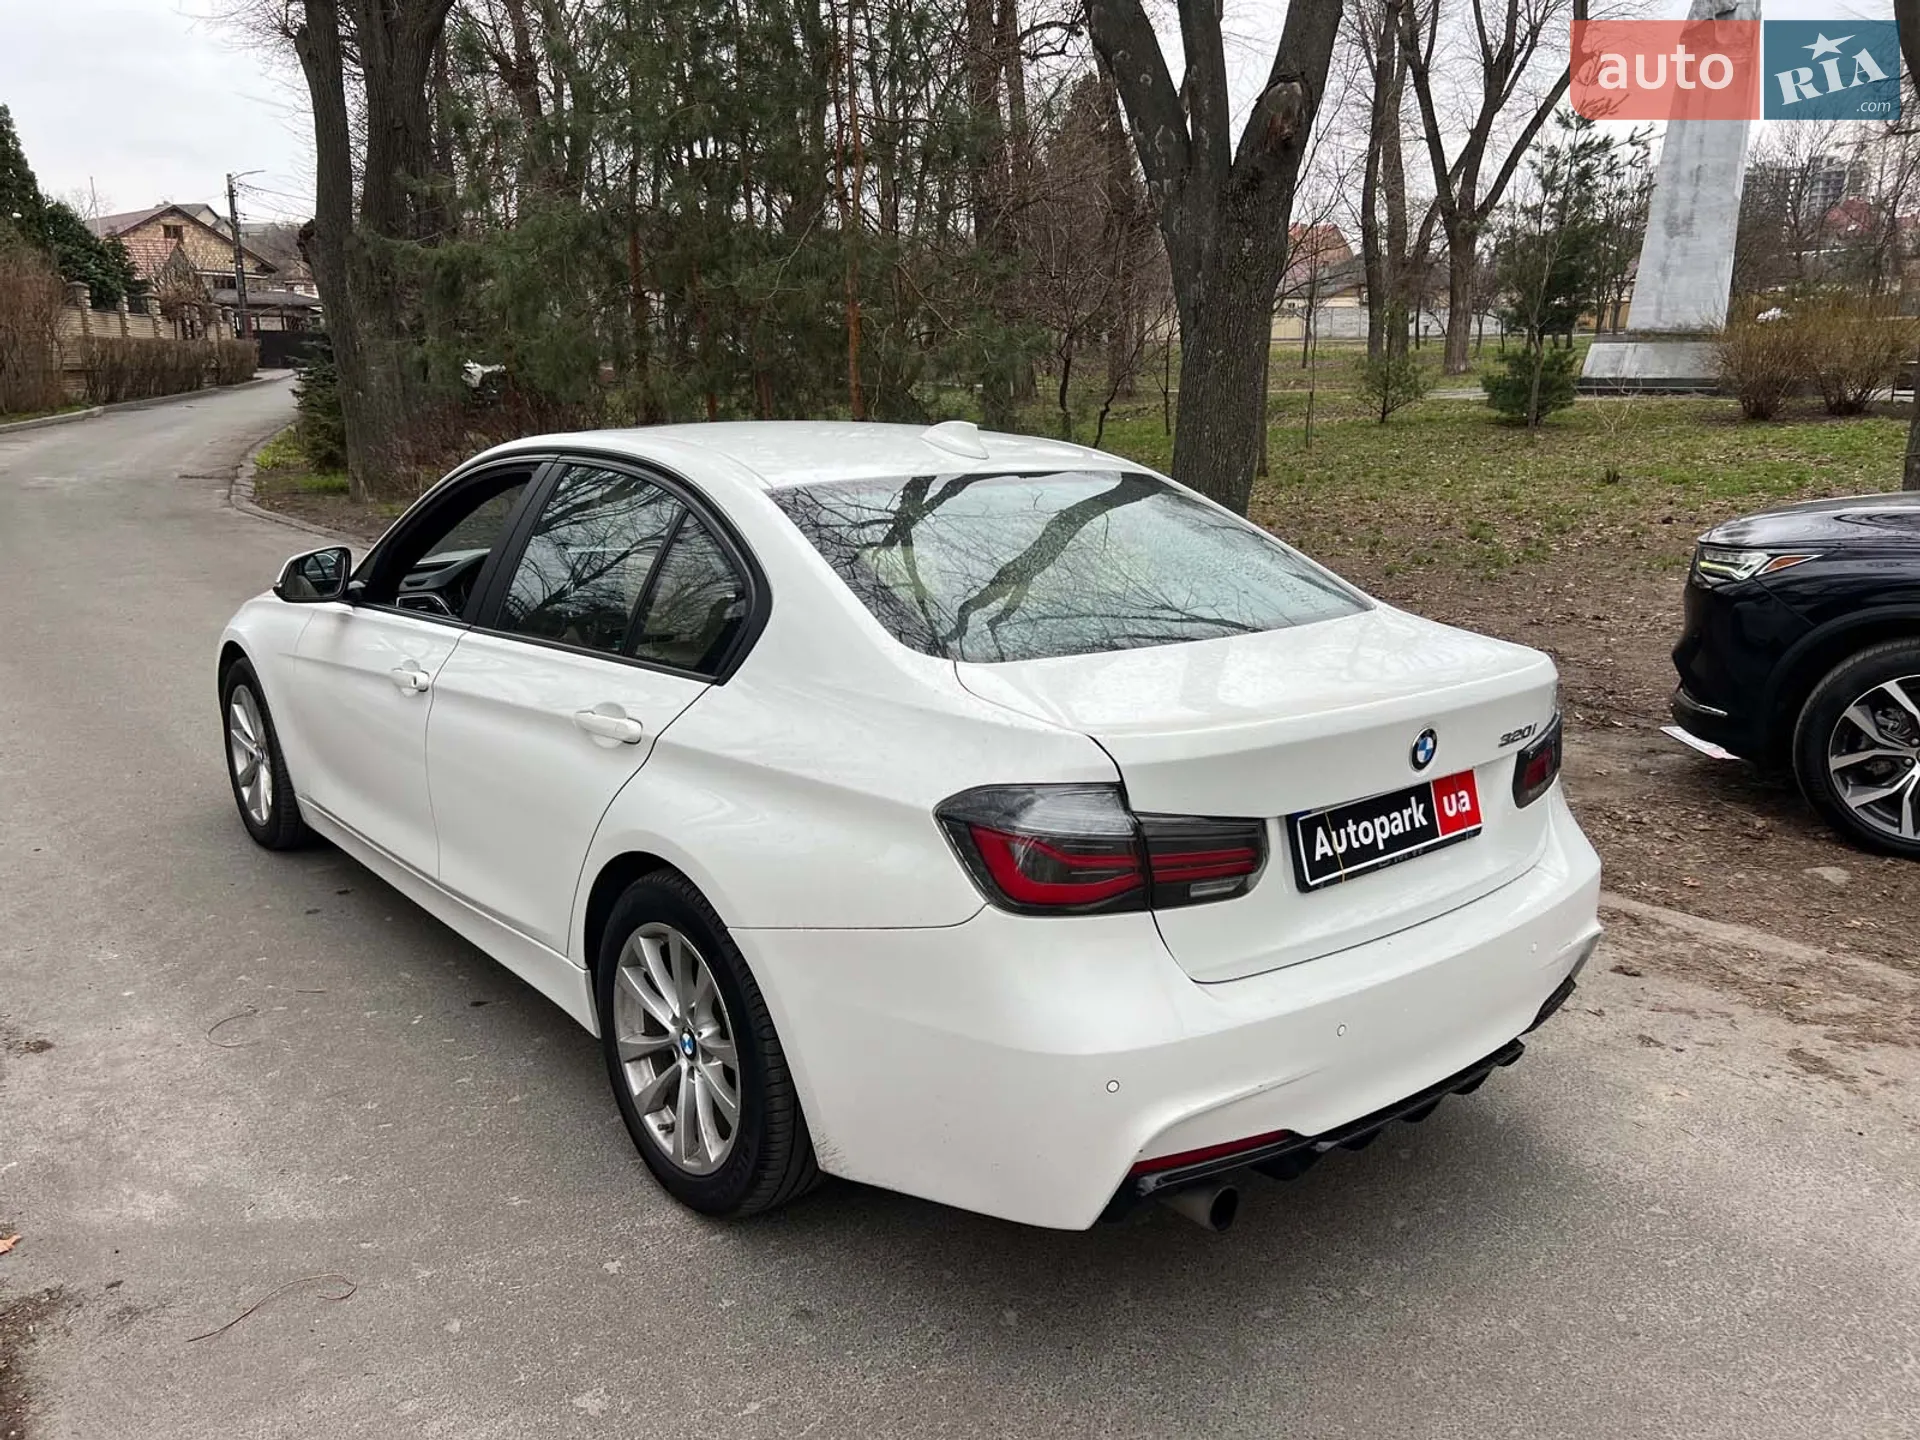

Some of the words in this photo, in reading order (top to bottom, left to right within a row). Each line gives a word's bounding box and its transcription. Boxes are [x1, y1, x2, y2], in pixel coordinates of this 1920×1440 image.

[1498, 722, 1537, 748] 320i
[1314, 796, 1428, 861] Autopark
[1442, 790, 1471, 817] ua
